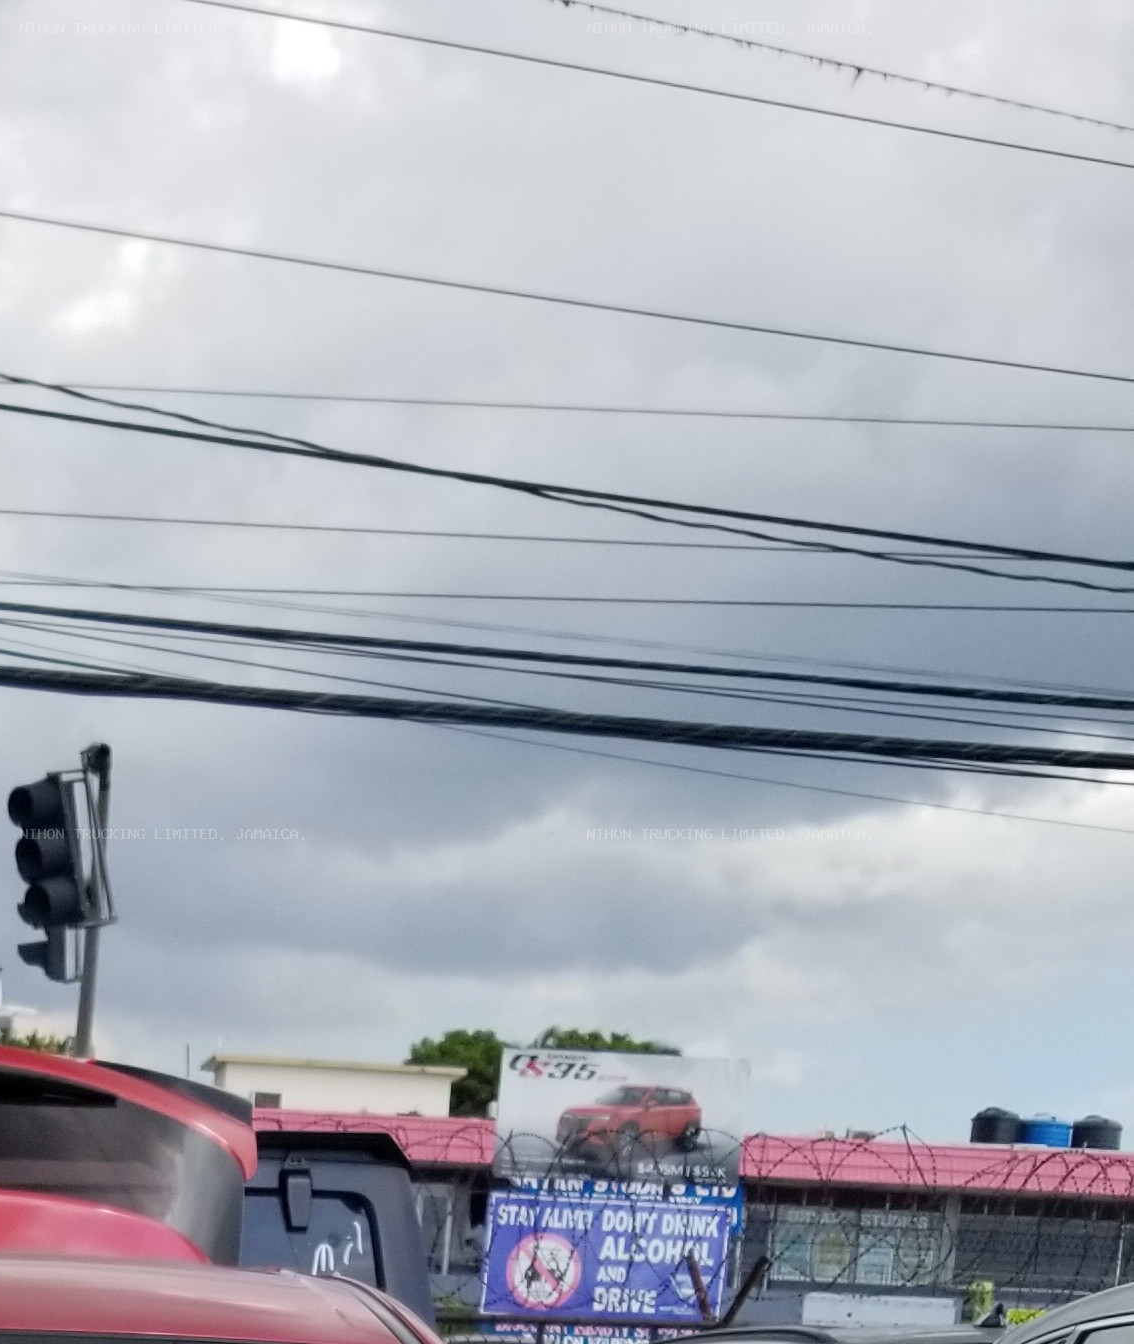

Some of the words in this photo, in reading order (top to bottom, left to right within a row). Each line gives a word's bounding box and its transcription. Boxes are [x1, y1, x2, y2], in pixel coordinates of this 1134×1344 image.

[497, 1205, 538, 1228] STAY
[661, 1212, 720, 1239] DRINK
[599, 1235, 714, 1267] ALCOHOL
[596, 1266, 627, 1284] AND
[592, 1286, 658, 1315] DRIVE
